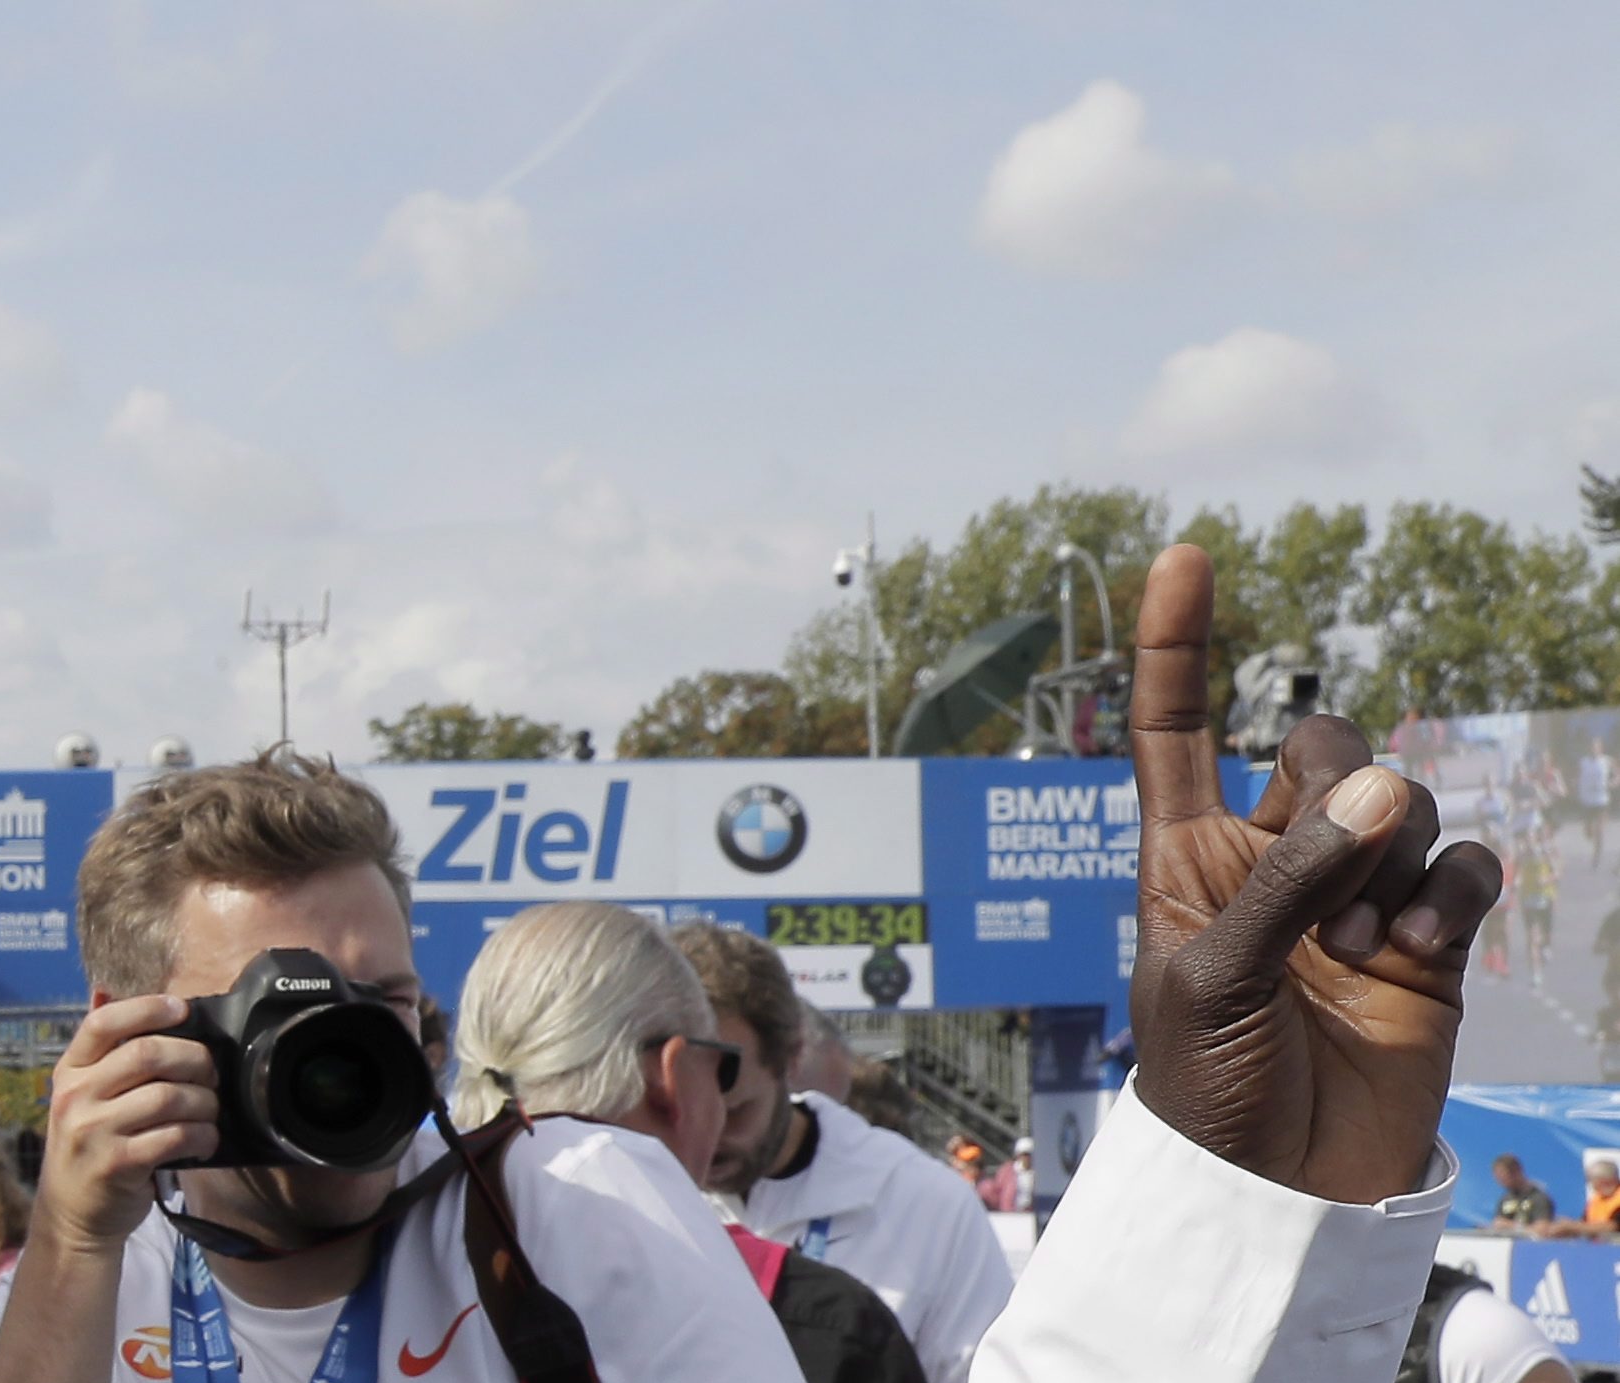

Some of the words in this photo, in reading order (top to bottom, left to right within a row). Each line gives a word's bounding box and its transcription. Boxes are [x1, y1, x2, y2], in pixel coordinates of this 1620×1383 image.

[987, 785, 1099, 824] BMW
[416, 779, 631, 883] Ziel
[987, 823, 1102, 851] BERLIN
[768, 903, 924, 946] 2:39:34
[274, 975, 331, 992] Canon
